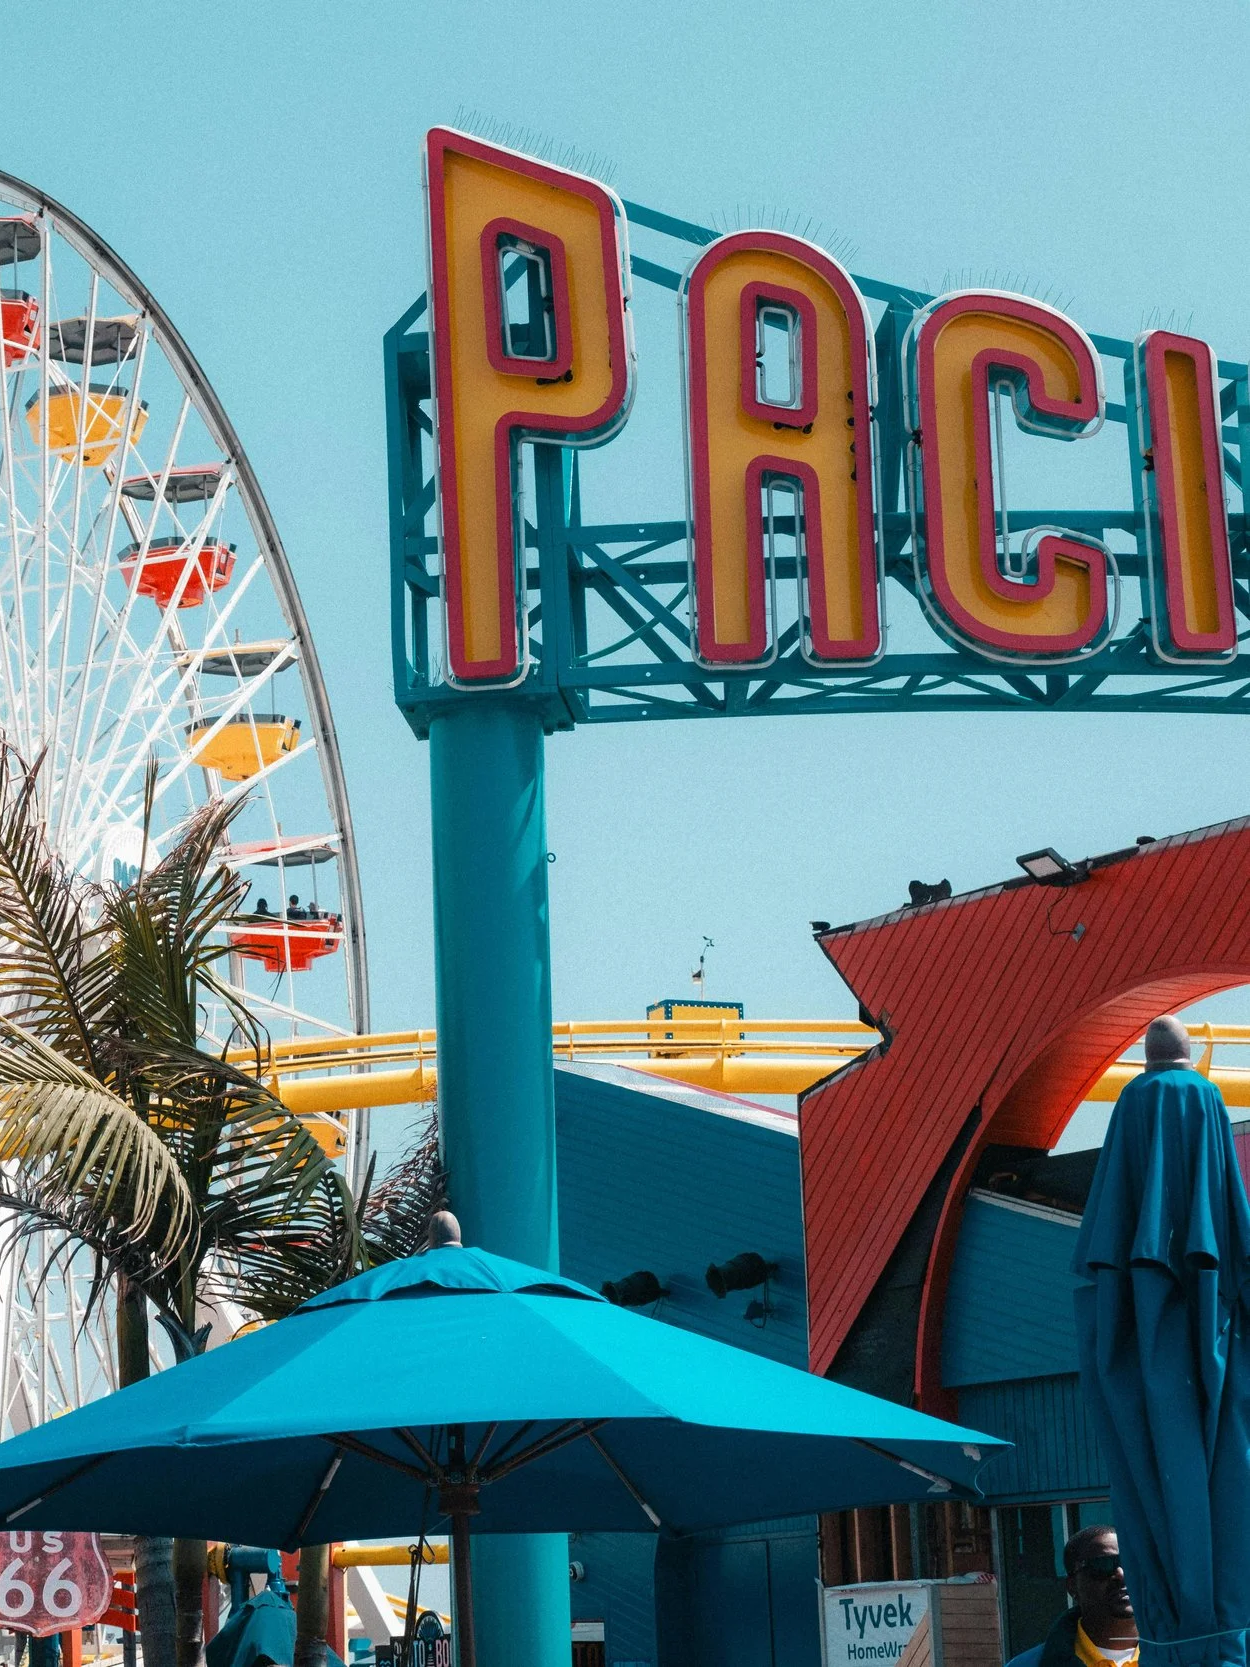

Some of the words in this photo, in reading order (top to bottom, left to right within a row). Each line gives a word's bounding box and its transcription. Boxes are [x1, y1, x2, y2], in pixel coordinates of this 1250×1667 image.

[422, 126, 1240, 688] PACI
[9, 1531, 64, 1553] US
[839, 1593, 914, 1640] Tyvek
[847, 1641, 908, 1661] HomeWr
